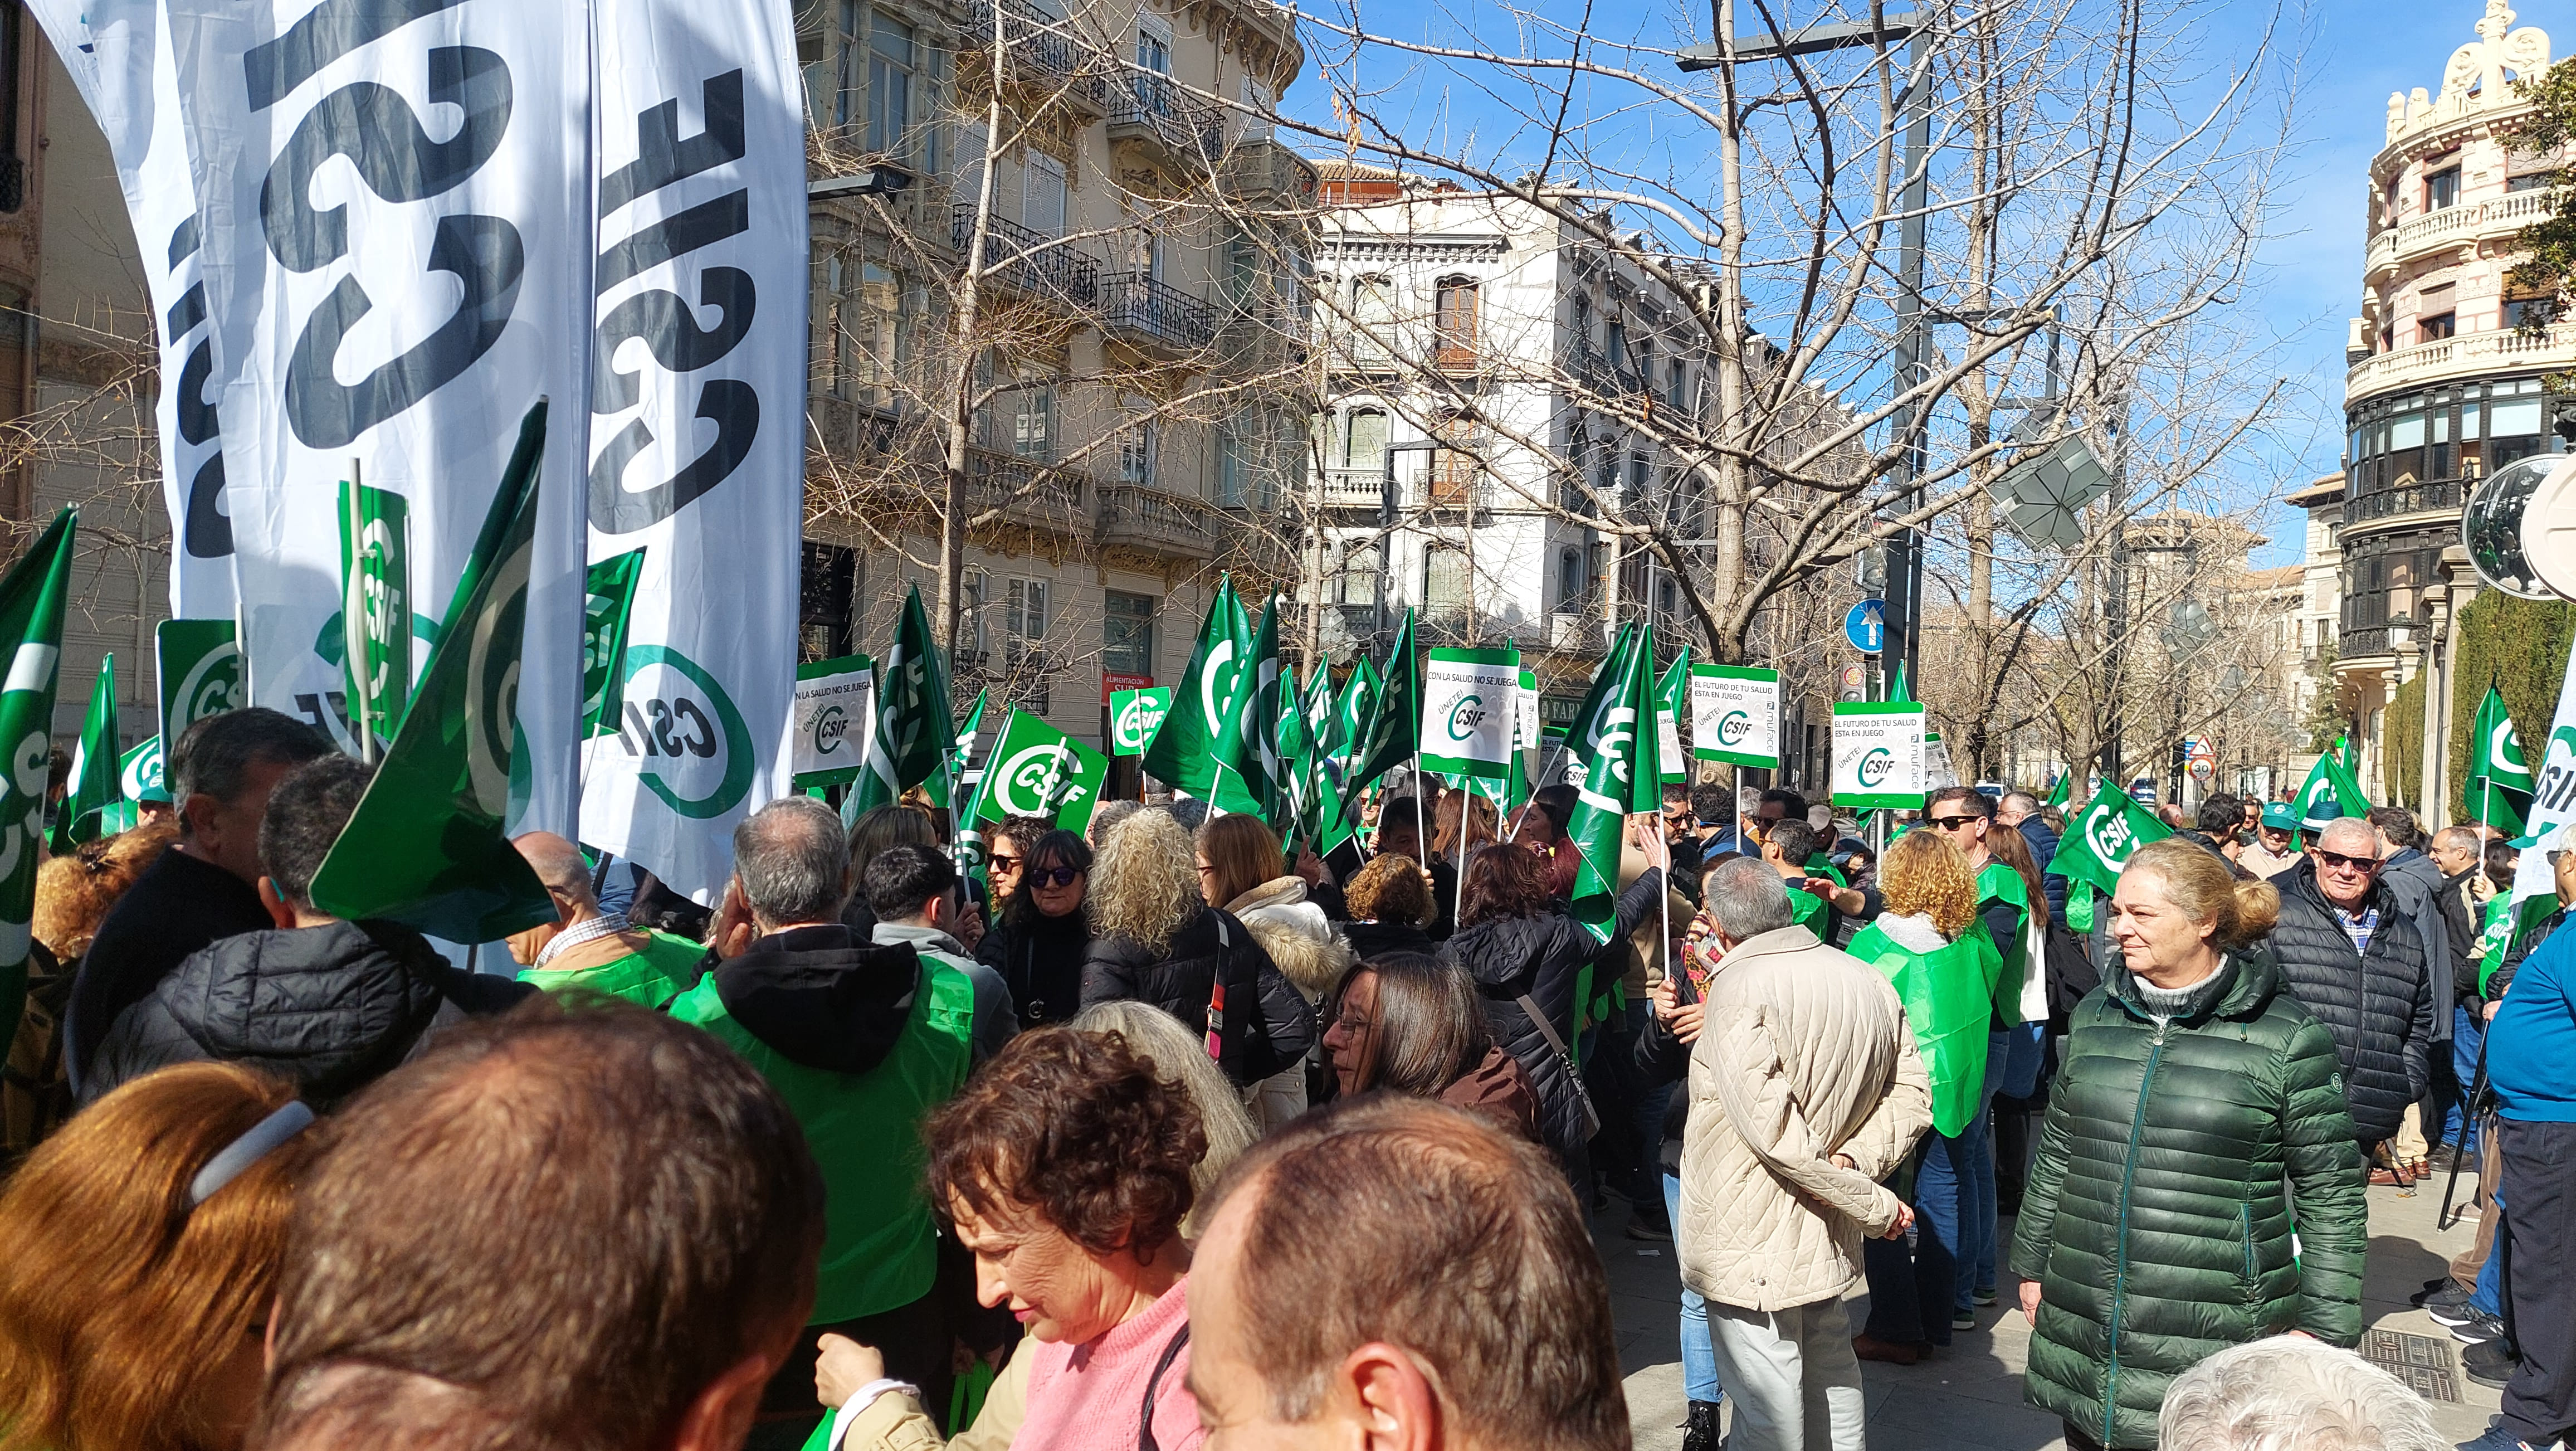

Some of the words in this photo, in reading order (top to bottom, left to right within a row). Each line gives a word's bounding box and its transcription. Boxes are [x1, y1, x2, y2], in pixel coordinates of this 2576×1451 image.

[811, 687, 831, 698] SALUD
[832, 685, 842, 694] NO
[843, 684, 850, 693] SE
[851, 681, 872, 691] JUEGA
[1106, 676, 1144, 685] ALIMENTACIÓN
[1452, 674, 1473, 683] SALUD
[1474, 676, 1485, 684] NO
[1486, 676, 1494, 685] SE
[1494, 677, 1517, 686] JUEGA
[1703, 682, 1729, 690] FUTURO
[1750, 686, 1773, 694] SALUD
[1438, 689, 1464, 714] ÚNETE!
[803, 703, 826, 732] ÚNETE!
[1125, 710, 1165, 731] CSIF
[1455, 709, 1486, 727] CSIF
[1698, 707, 1721, 726] ÚNETE!
[821, 719, 849, 739] CSIF
[1724, 720, 1753, 735] CSIF
[1767, 711, 1775, 752] muface
[1838, 746, 1862, 768] ÚNETE!
[1865, 759, 1895, 774] CSIF
[1563, 771, 1588, 782] CSIF
[1910, 745, 1921, 789] muface
[2194, 764, 2209, 773] 30
[1016, 763, 1088, 807] CSIF
[2099, 810, 2132, 856] CSIF
